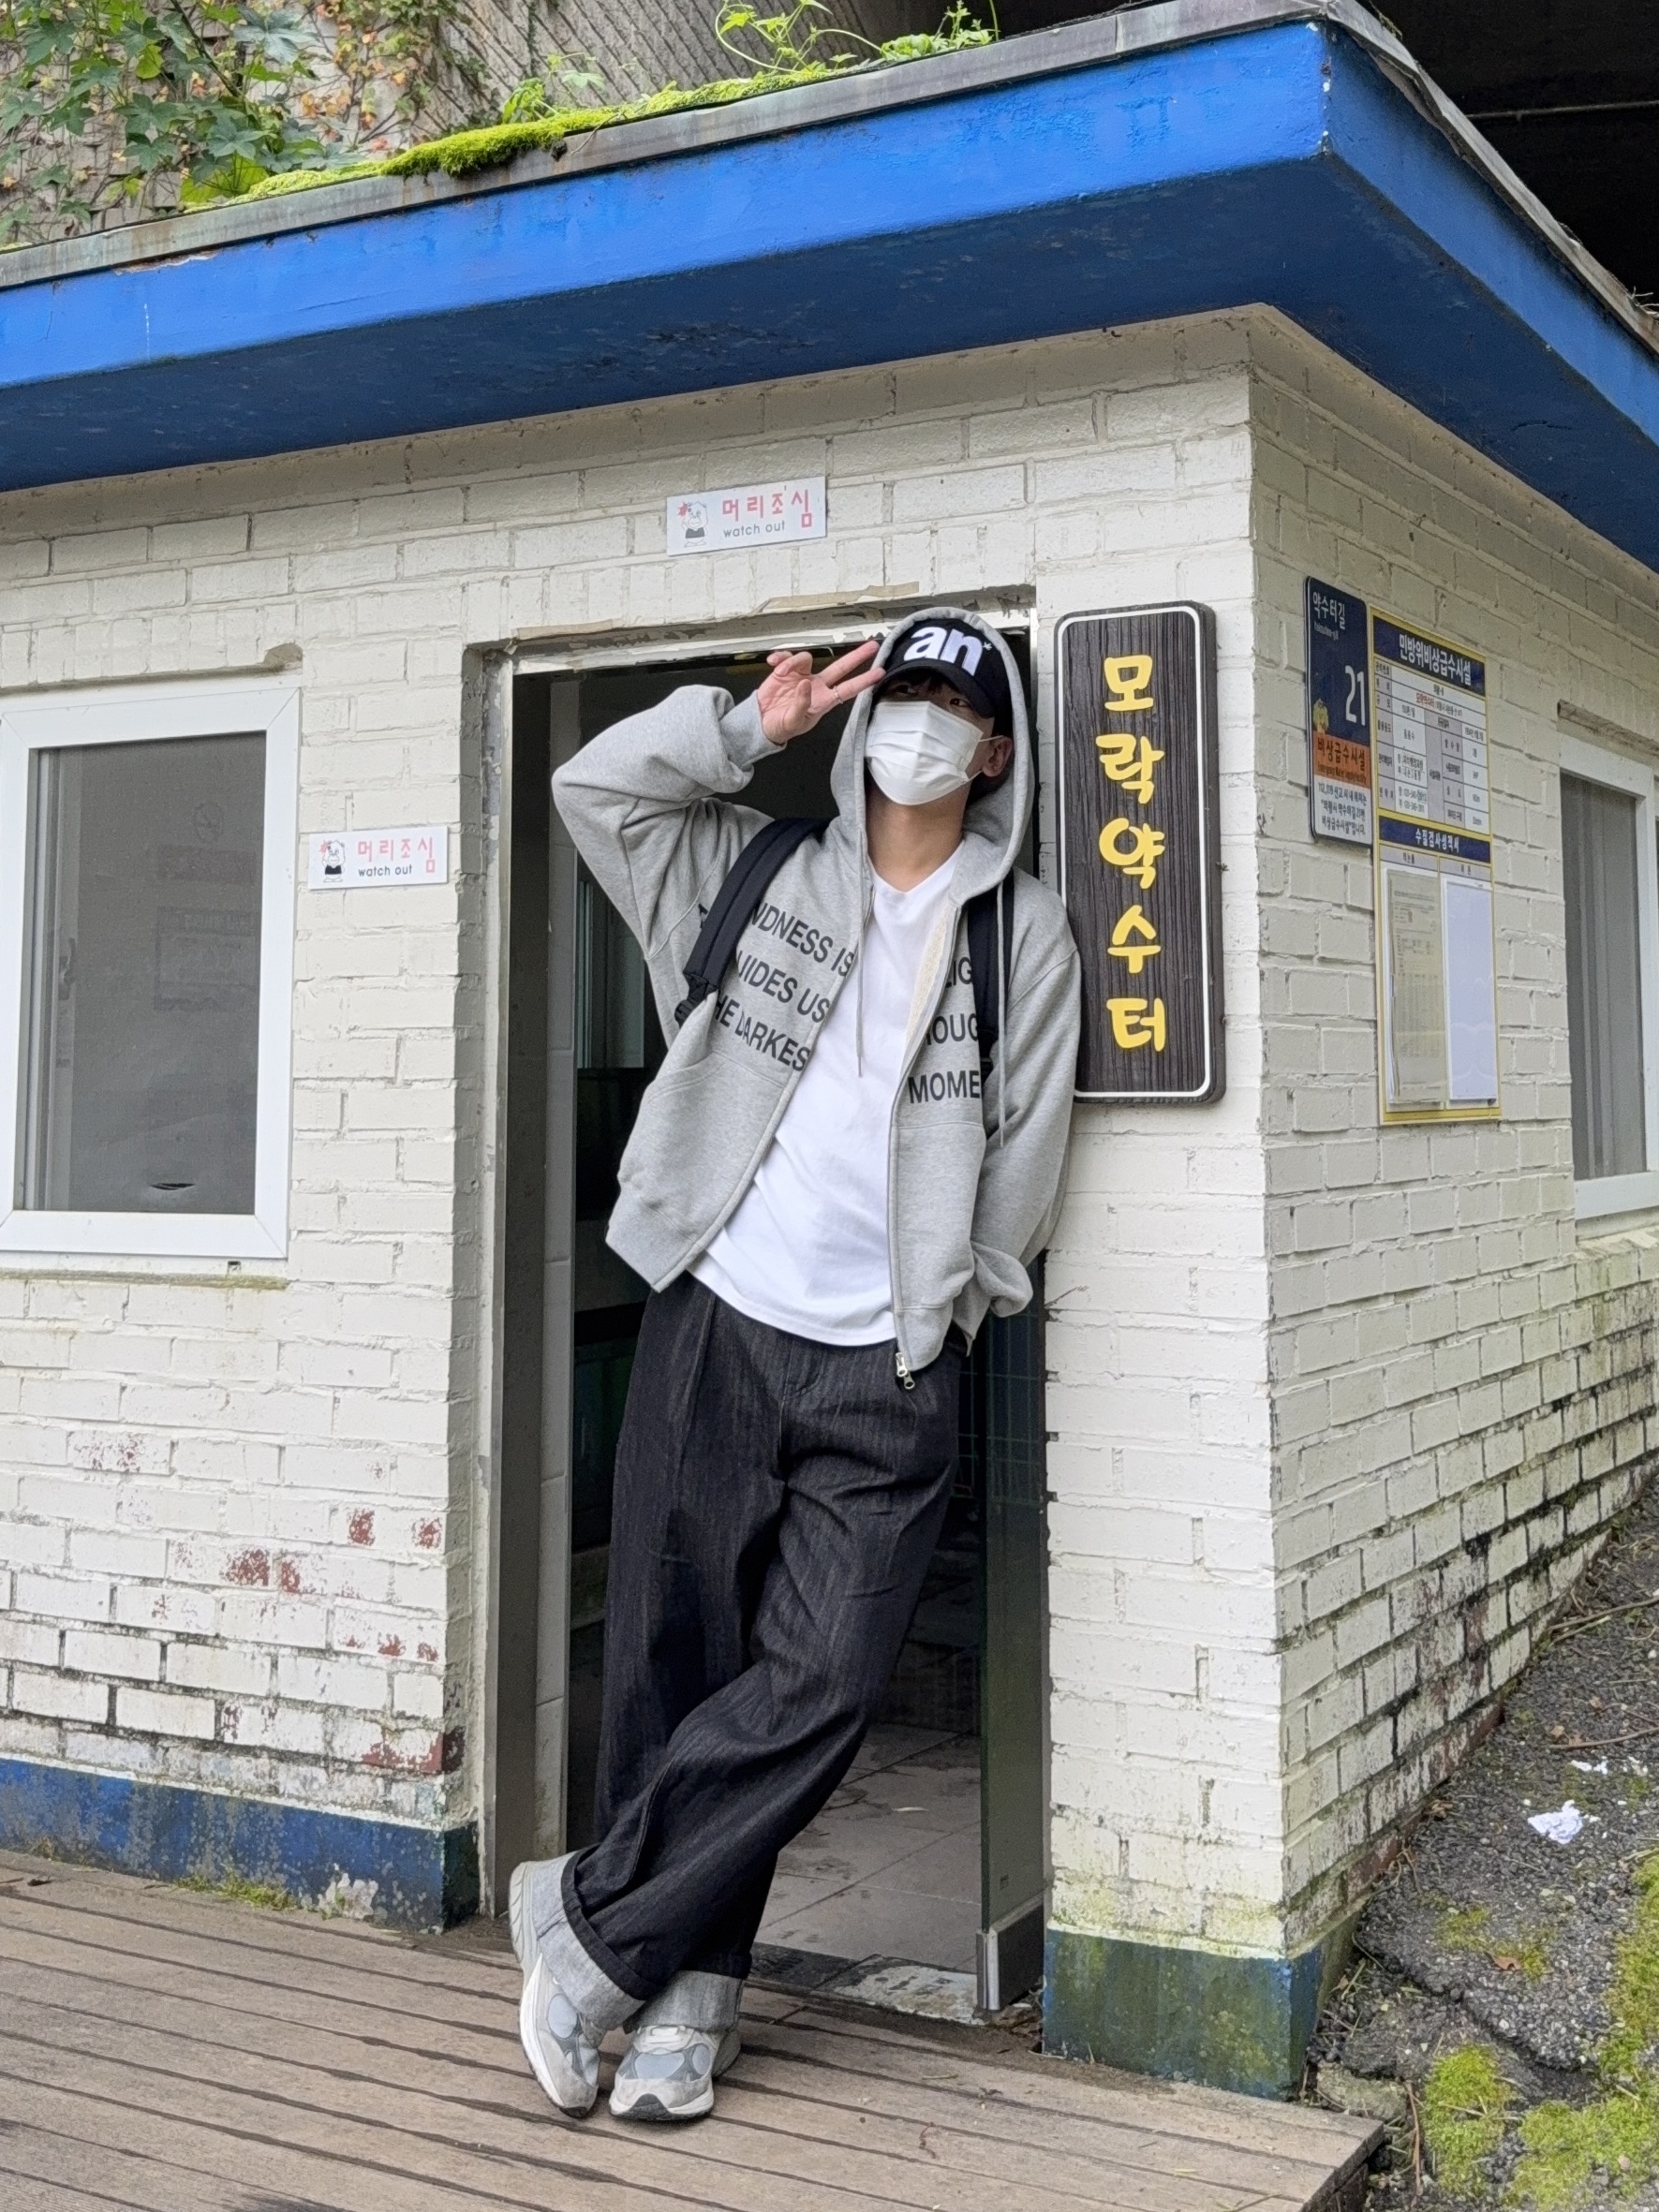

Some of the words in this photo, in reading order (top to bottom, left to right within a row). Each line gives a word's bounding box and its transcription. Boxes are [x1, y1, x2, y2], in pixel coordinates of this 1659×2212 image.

[722, 489, 813, 528] 머리조심
[723, 524, 761, 538] watch
[765, 521, 786, 533] out
[1312, 591, 1346, 630] 약수터길
[1399, 633, 1472, 686] 민방위비상급수시설
[1344, 665, 1367, 727] 21
[1317, 737, 1366, 772] 비상급수시설
[358, 836, 436, 874] 머리조심
[1096, 654, 1168, 1054] 모락약수터
[1415, 828, 1459, 853] 수질검사성적서
[358, 865, 391, 877] watch
[394, 863, 412, 876] out
[750, 903, 833, 963] NDNESS
[831, 948, 854, 977] IS
[945, 956, 972, 988] IG
[797, 988, 830, 1023] US
[926, 1013, 978, 1045] OUG
[908, 1069, 981, 1103] MOME
